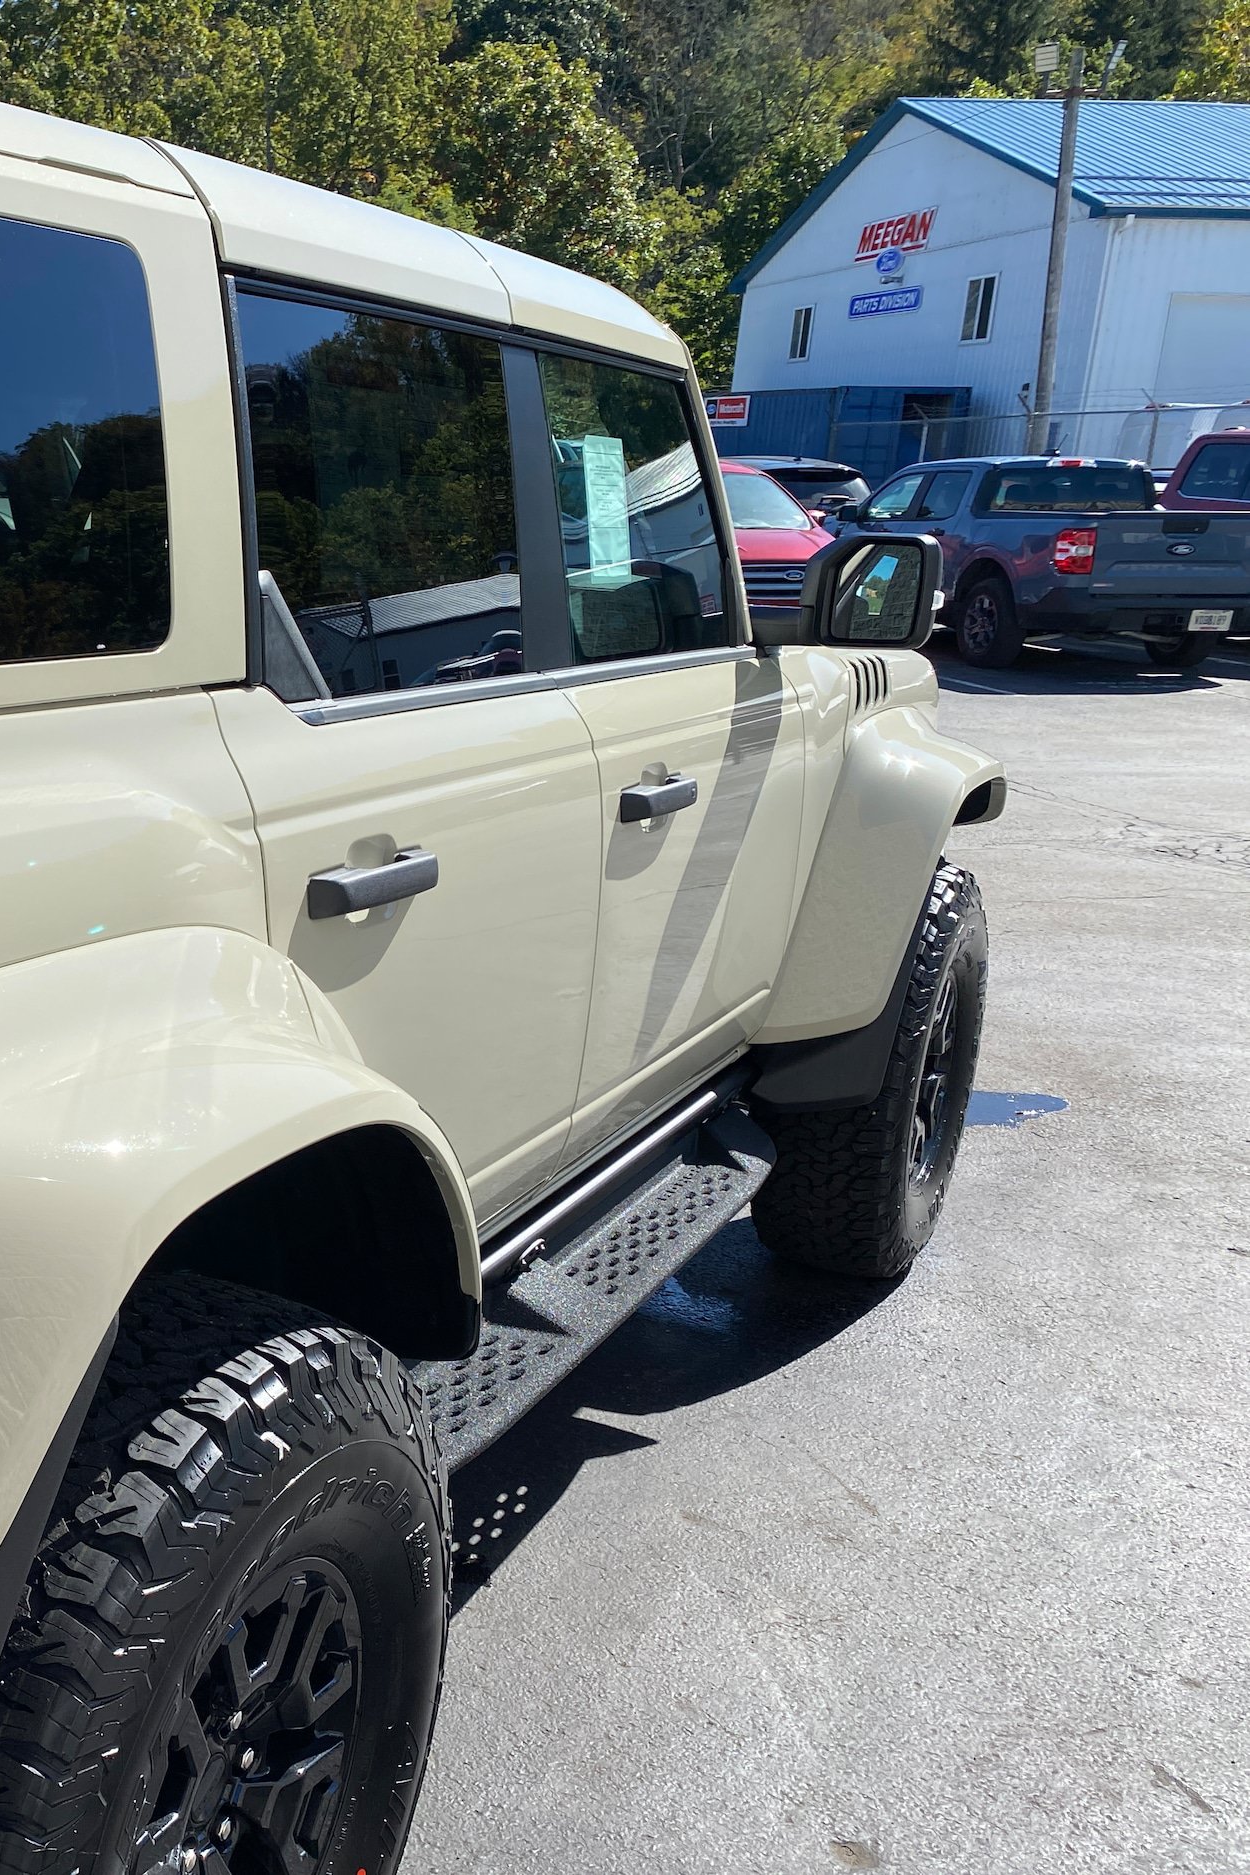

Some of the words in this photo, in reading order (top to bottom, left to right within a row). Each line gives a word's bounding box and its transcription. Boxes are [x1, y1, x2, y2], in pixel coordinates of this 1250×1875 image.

[856, 209, 935, 254] MEEGAN
[852, 298, 879, 314] PARTS
[879, 291, 918, 310] DIVISION
